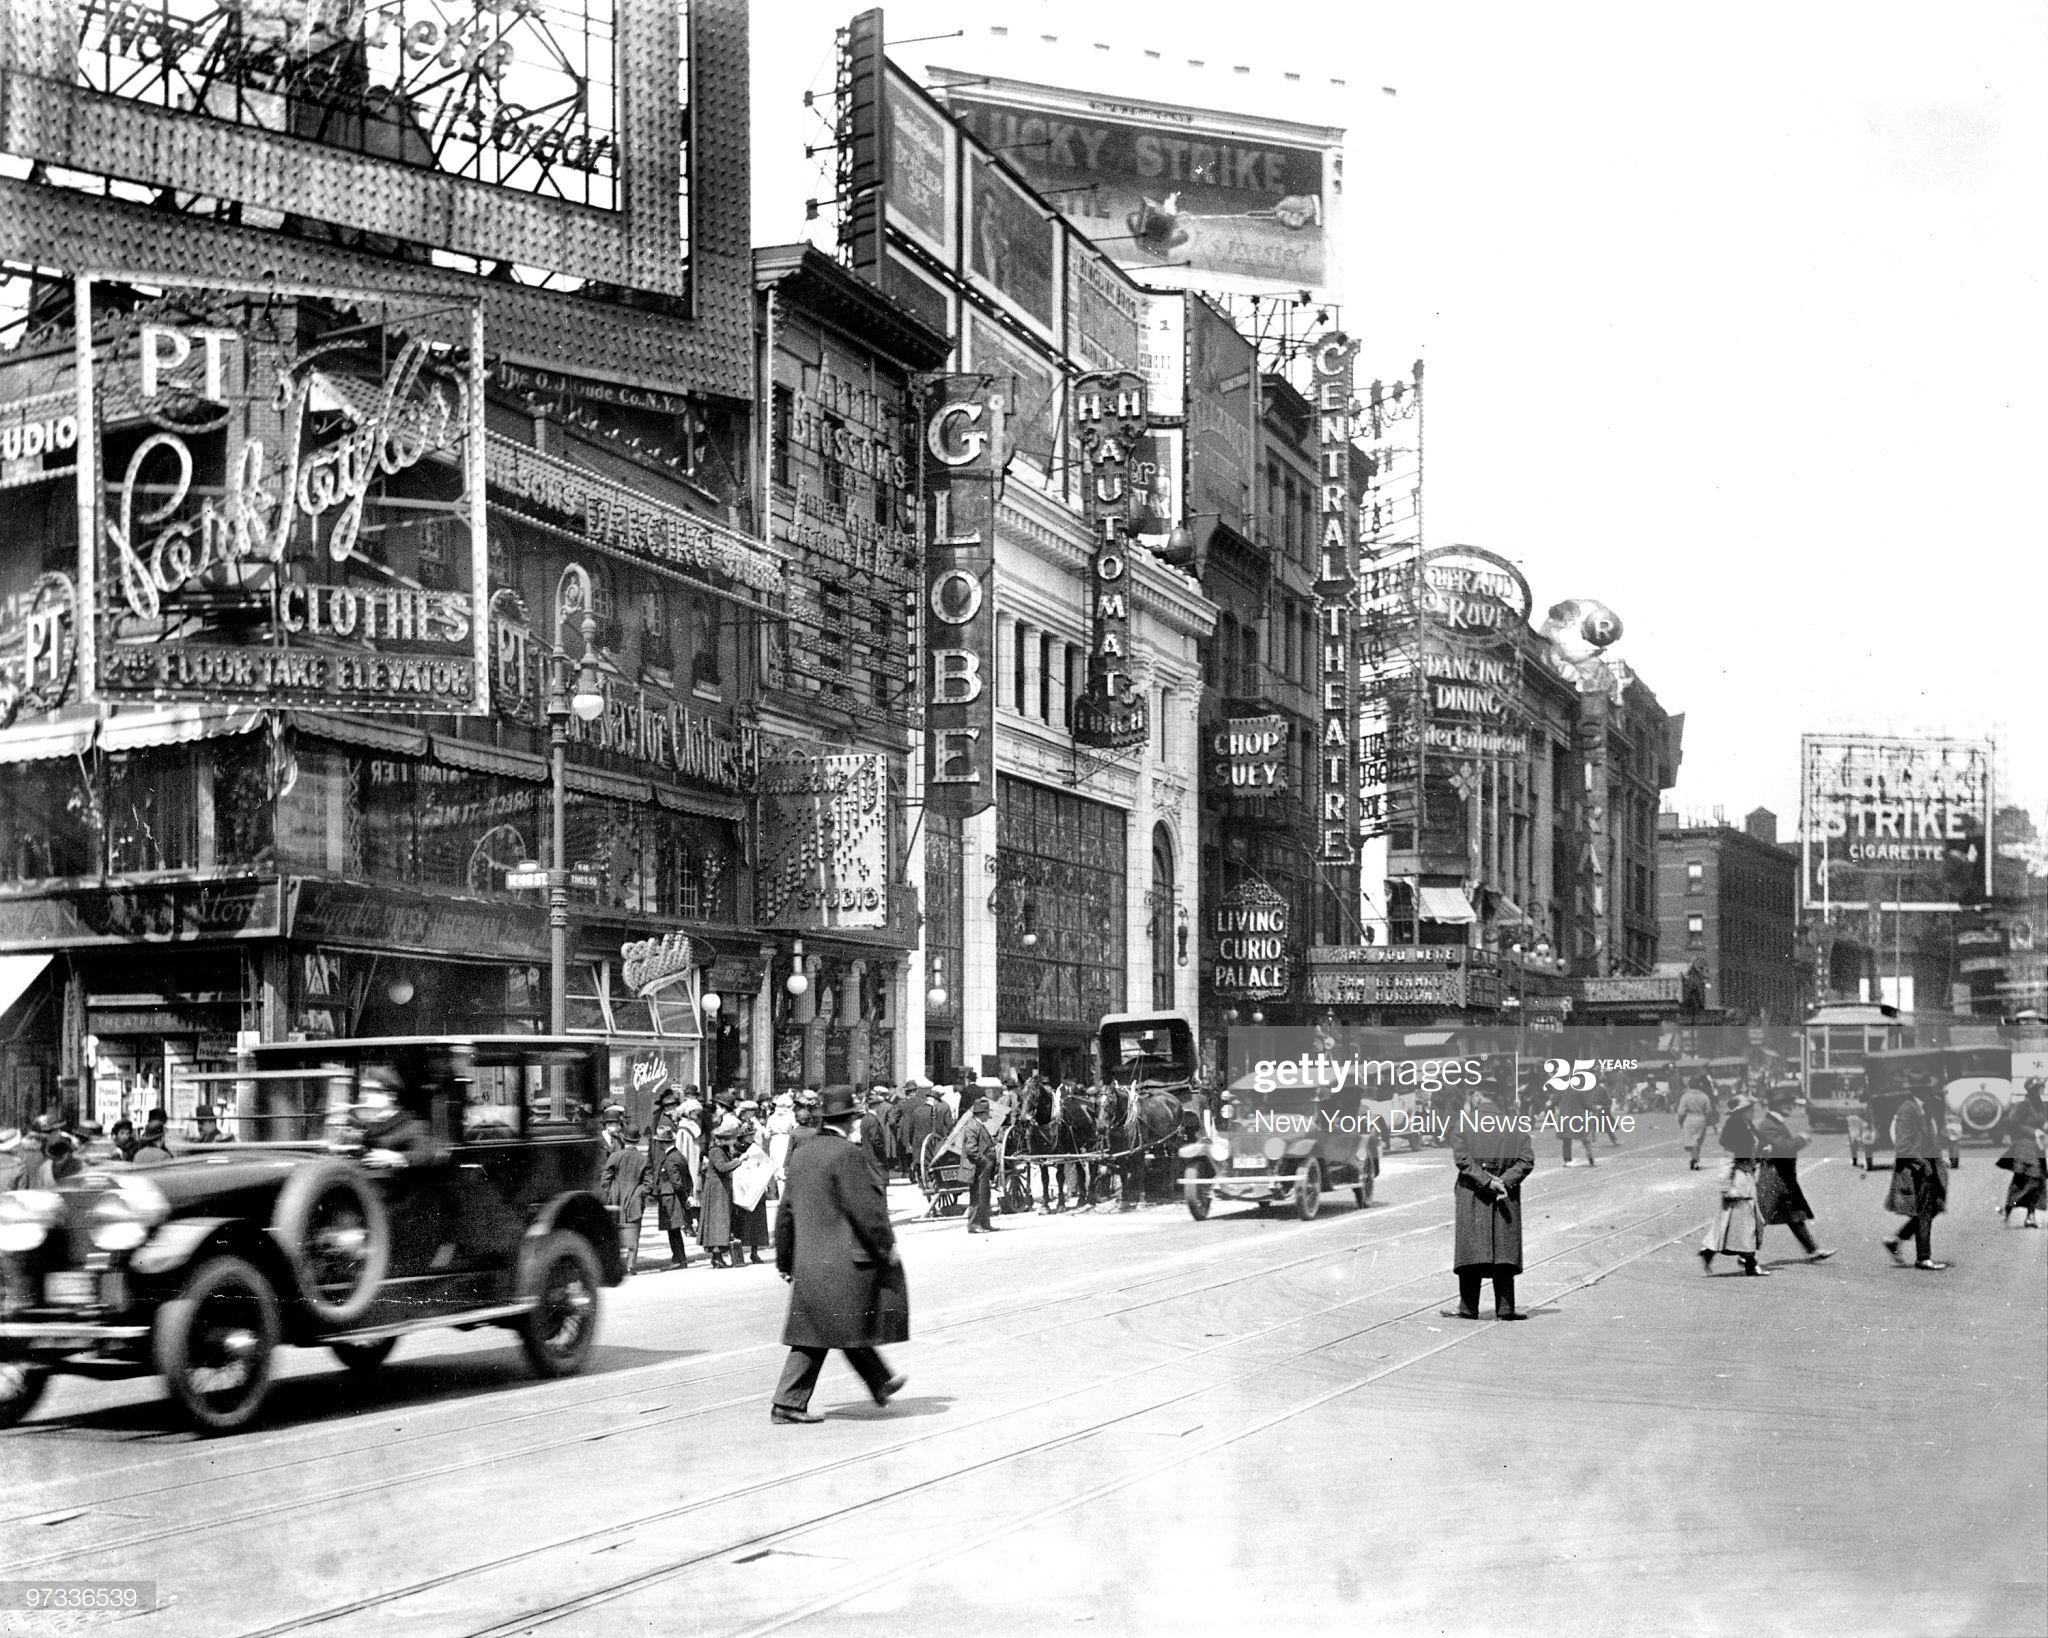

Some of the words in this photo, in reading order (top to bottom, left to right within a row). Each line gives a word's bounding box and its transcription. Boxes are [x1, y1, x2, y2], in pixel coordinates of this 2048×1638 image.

[1136, 135, 1287, 194] STRIKE
[141, 326, 238, 400] PT
[574, 381, 613, 400] ude
[791, 386, 906, 489] BLOSSOMS
[1315, 343, 1348, 582] CENTRAL
[1097, 439, 1126, 697] AUTOMAT
[280, 582, 470, 642] CLOTHES
[928, 402, 988, 784] GLOBE
[26, 606, 64, 688] PT
[160, 651, 252, 685] FLOOR
[263, 653, 328, 687] TAKE
[336, 655, 470, 695] ELEVATOR
[1436, 684, 1500, 714] DINING
[1214, 732, 1279, 755] CHOP
[1323, 605, 1347, 858] THEATRE
[1215, 763, 1278, 786] SUEY
[1822, 800, 1966, 840] STRIKE
[1850, 843, 1945, 862] CIGARETTE
[798, 887, 881, 912] STUDIO
[1217, 909, 1284, 932] LIVING
[1219, 937, 1281, 960] CURIO
[1376, 950, 1406, 962] YOU
[1416, 949, 1454, 962] WERE
[1215, 964, 1282, 988] PALACE
[633, 1054, 668, 1093] Childs
